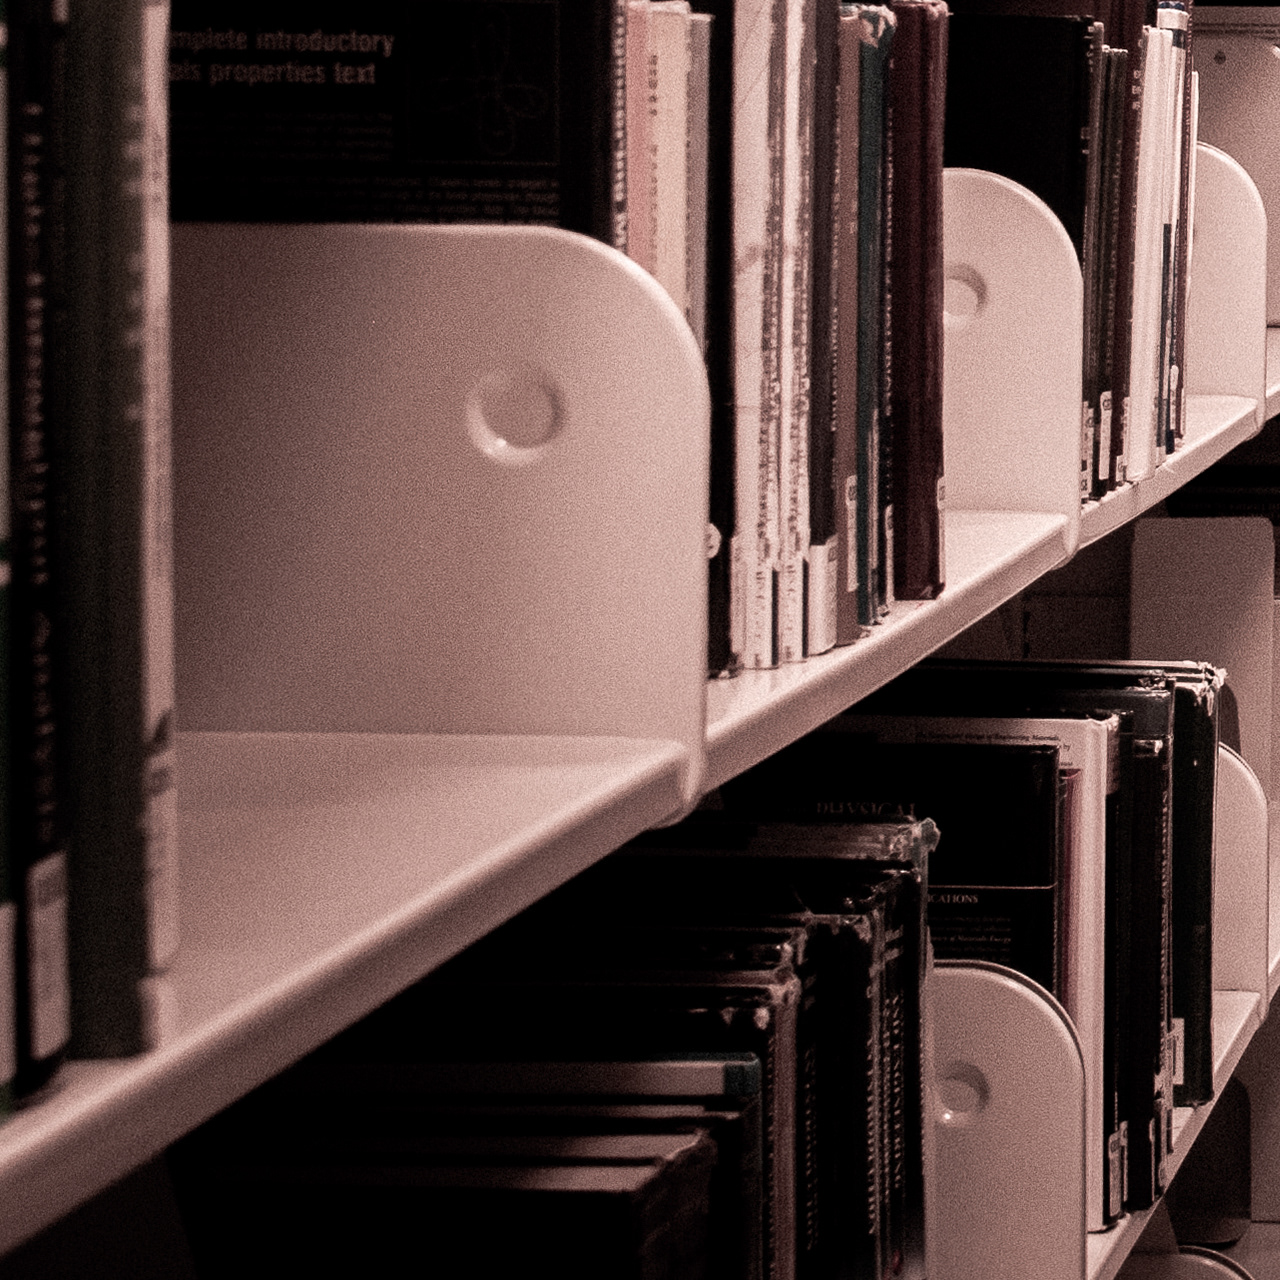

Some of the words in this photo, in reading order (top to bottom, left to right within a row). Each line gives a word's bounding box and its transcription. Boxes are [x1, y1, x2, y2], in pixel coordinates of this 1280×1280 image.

[256, 27, 395, 58] introductory
[209, 61, 327, 86] properties
[334, 61, 376, 84] text
